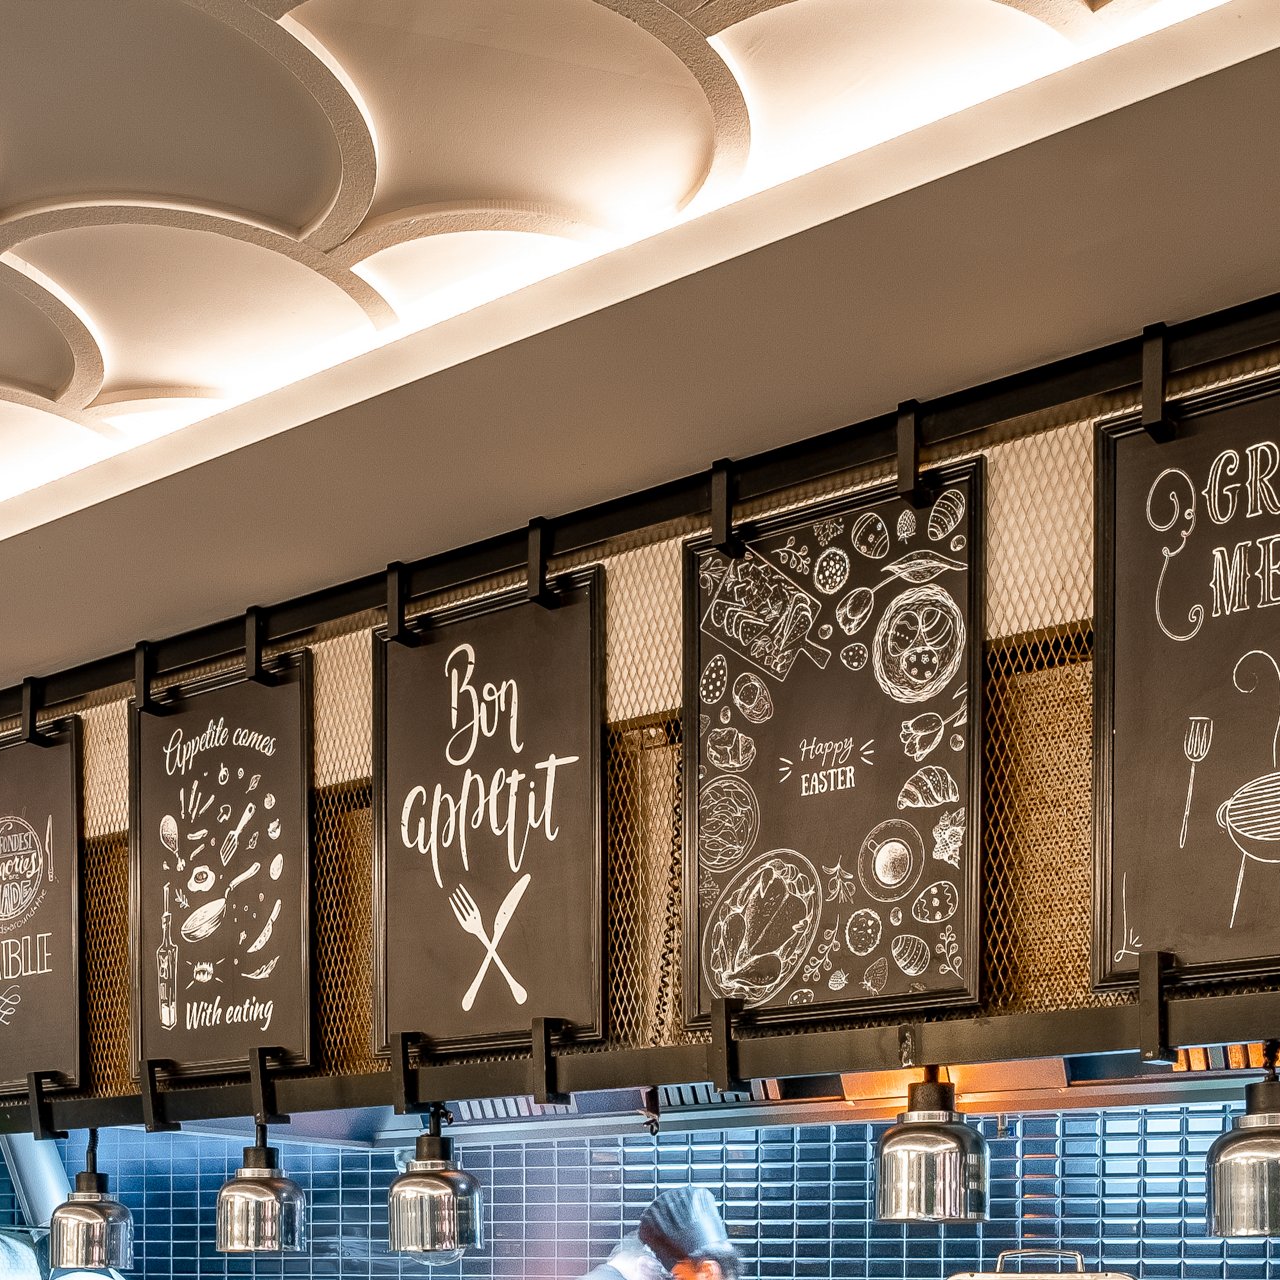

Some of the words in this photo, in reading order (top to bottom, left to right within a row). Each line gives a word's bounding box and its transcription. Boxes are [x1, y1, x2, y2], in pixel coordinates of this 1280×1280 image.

[445, 643, 524, 766] Bon
[163, 717, 229, 775] Appetite
[232, 727, 276, 757] comes
[799, 736, 854, 767] Happy
[800, 766, 855, 796] EASTER
[400, 753, 579, 888] appetit
[185, 995, 222, 1031] With
[225, 995, 274, 1031] eating
